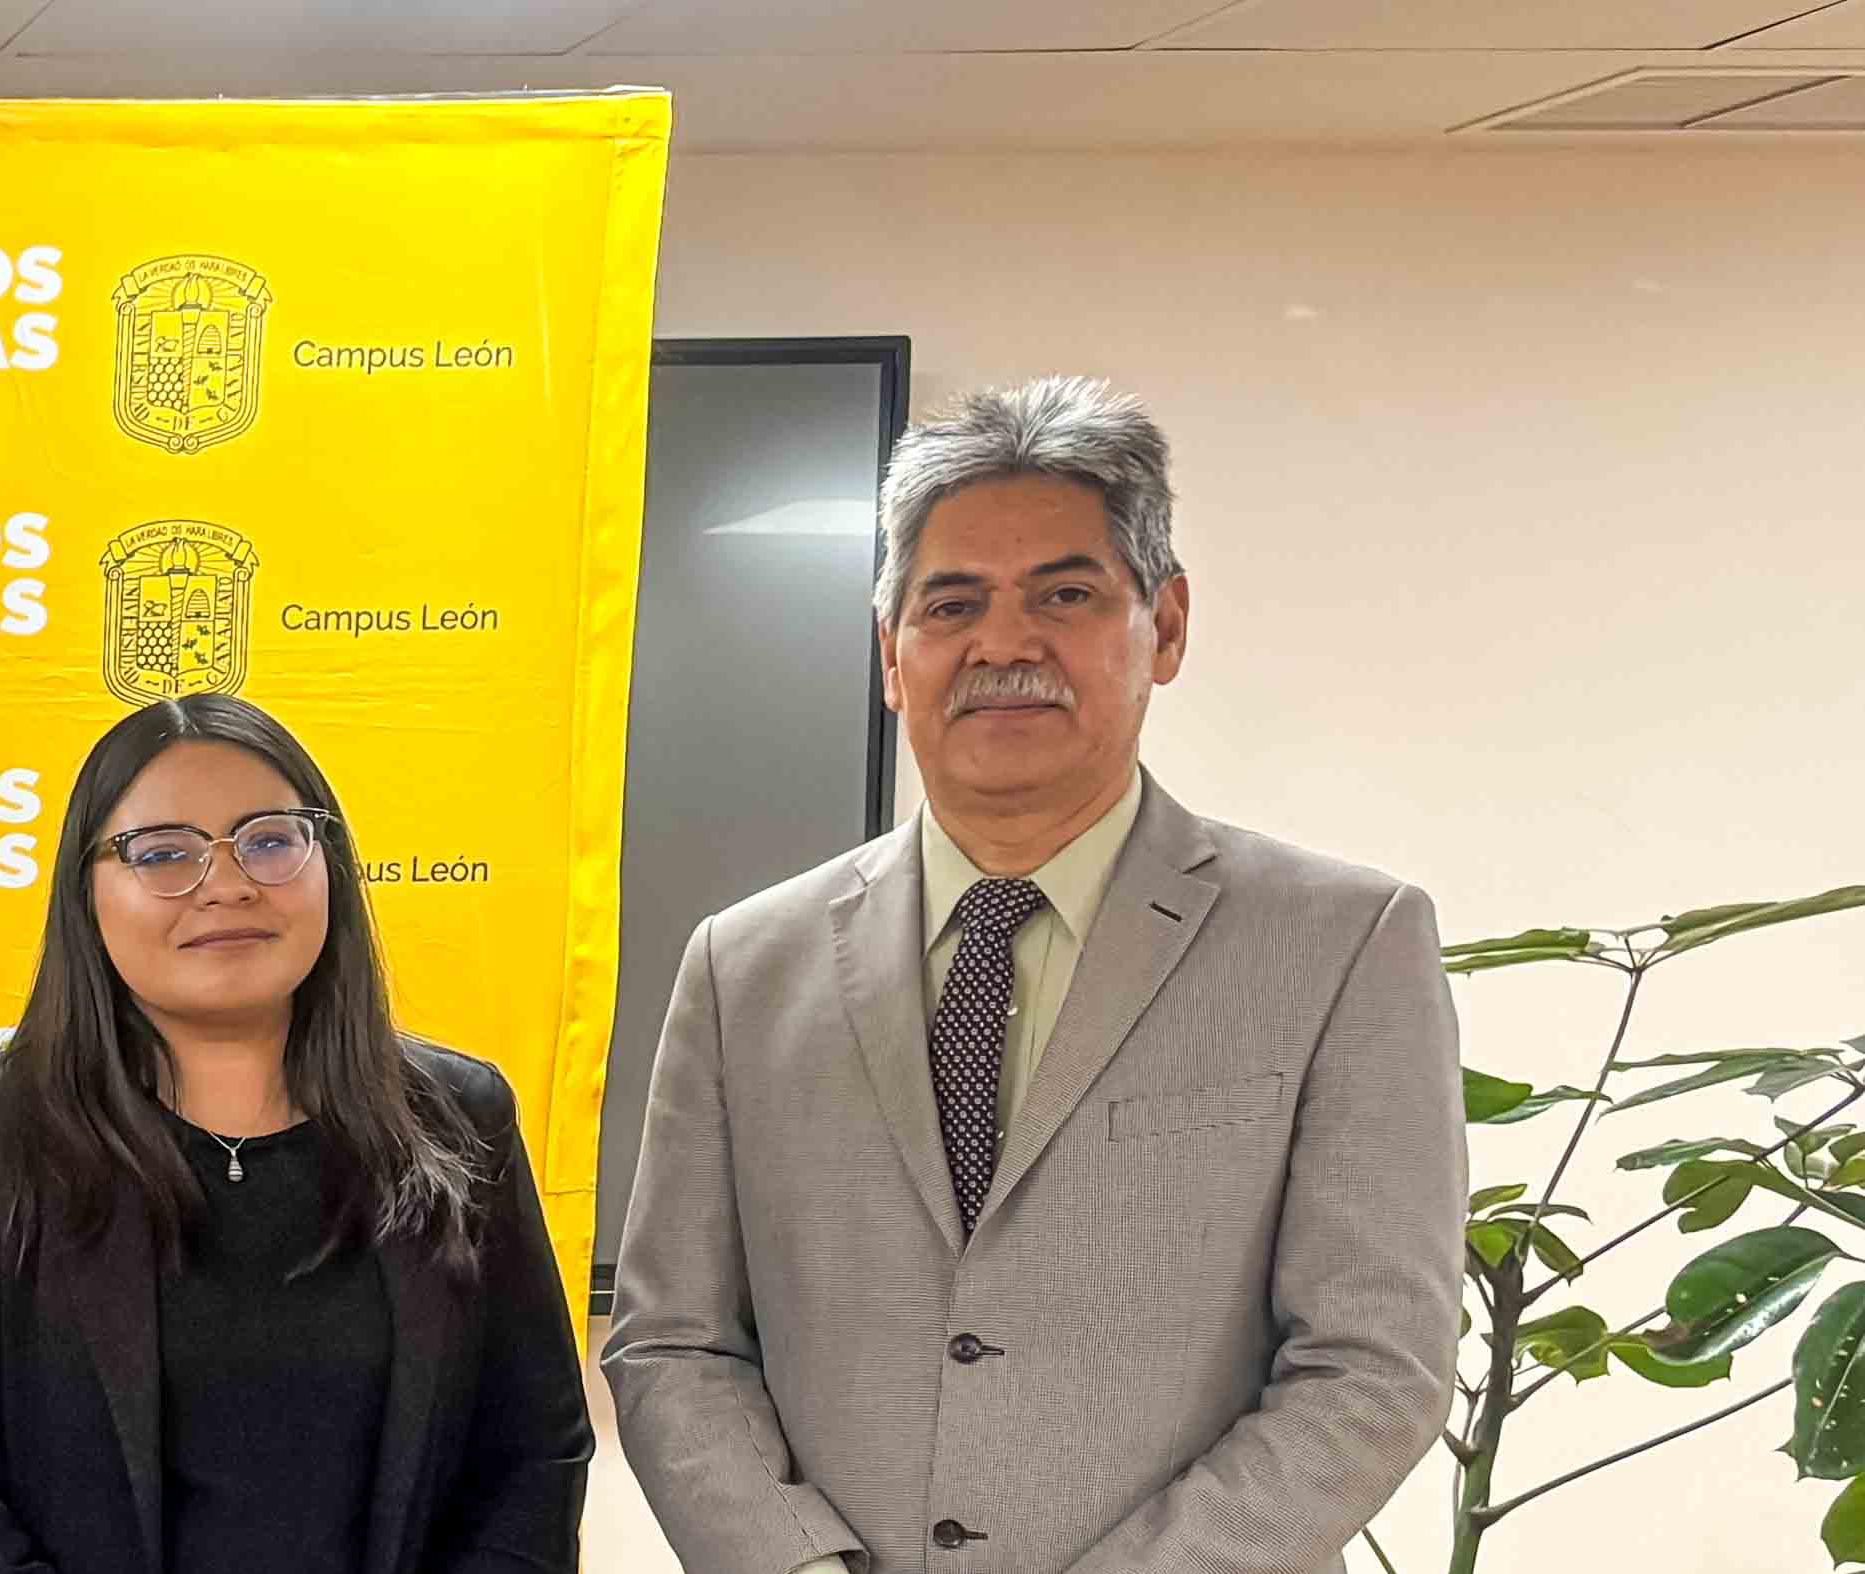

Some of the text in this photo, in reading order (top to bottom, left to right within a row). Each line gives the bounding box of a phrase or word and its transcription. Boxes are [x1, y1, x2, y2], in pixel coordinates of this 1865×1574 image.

[292, 338, 513, 377] Campus León
[280, 601, 499, 640] Campus León
[410, 854, 489, 884] León
